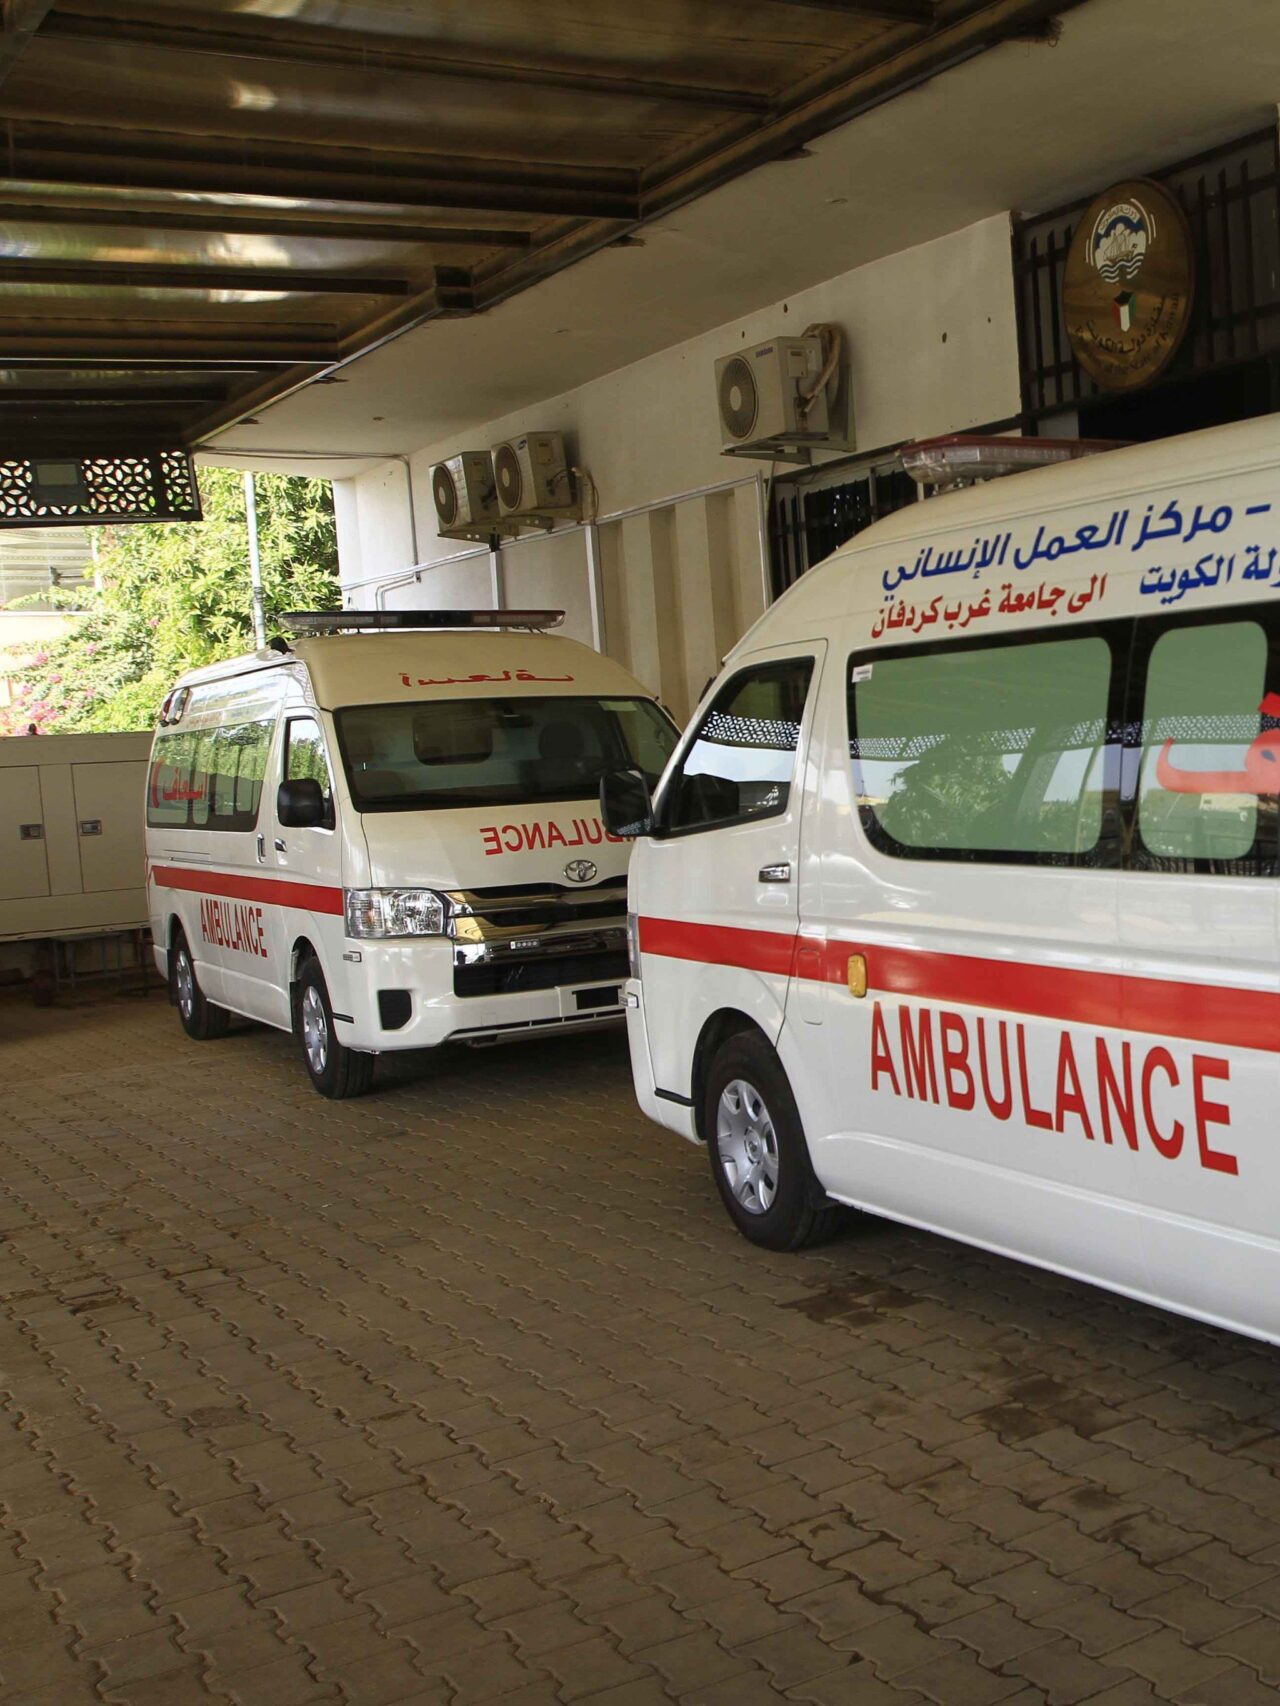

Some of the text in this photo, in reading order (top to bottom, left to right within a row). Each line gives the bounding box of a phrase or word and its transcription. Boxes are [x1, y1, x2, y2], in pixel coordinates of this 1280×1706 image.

[1013, 510, 1130, 569] العمل
[1131, 500, 1233, 551] مركز
[882, 532, 1012, 601] الإنساني
[1139, 553, 1236, 605] الكويت
[871, 572, 1108, 639] الى جامعة غرب كردفان
[200, 898, 268, 958] AMBULANCE
[870, 1000, 1240, 1176] AMBULANCE
